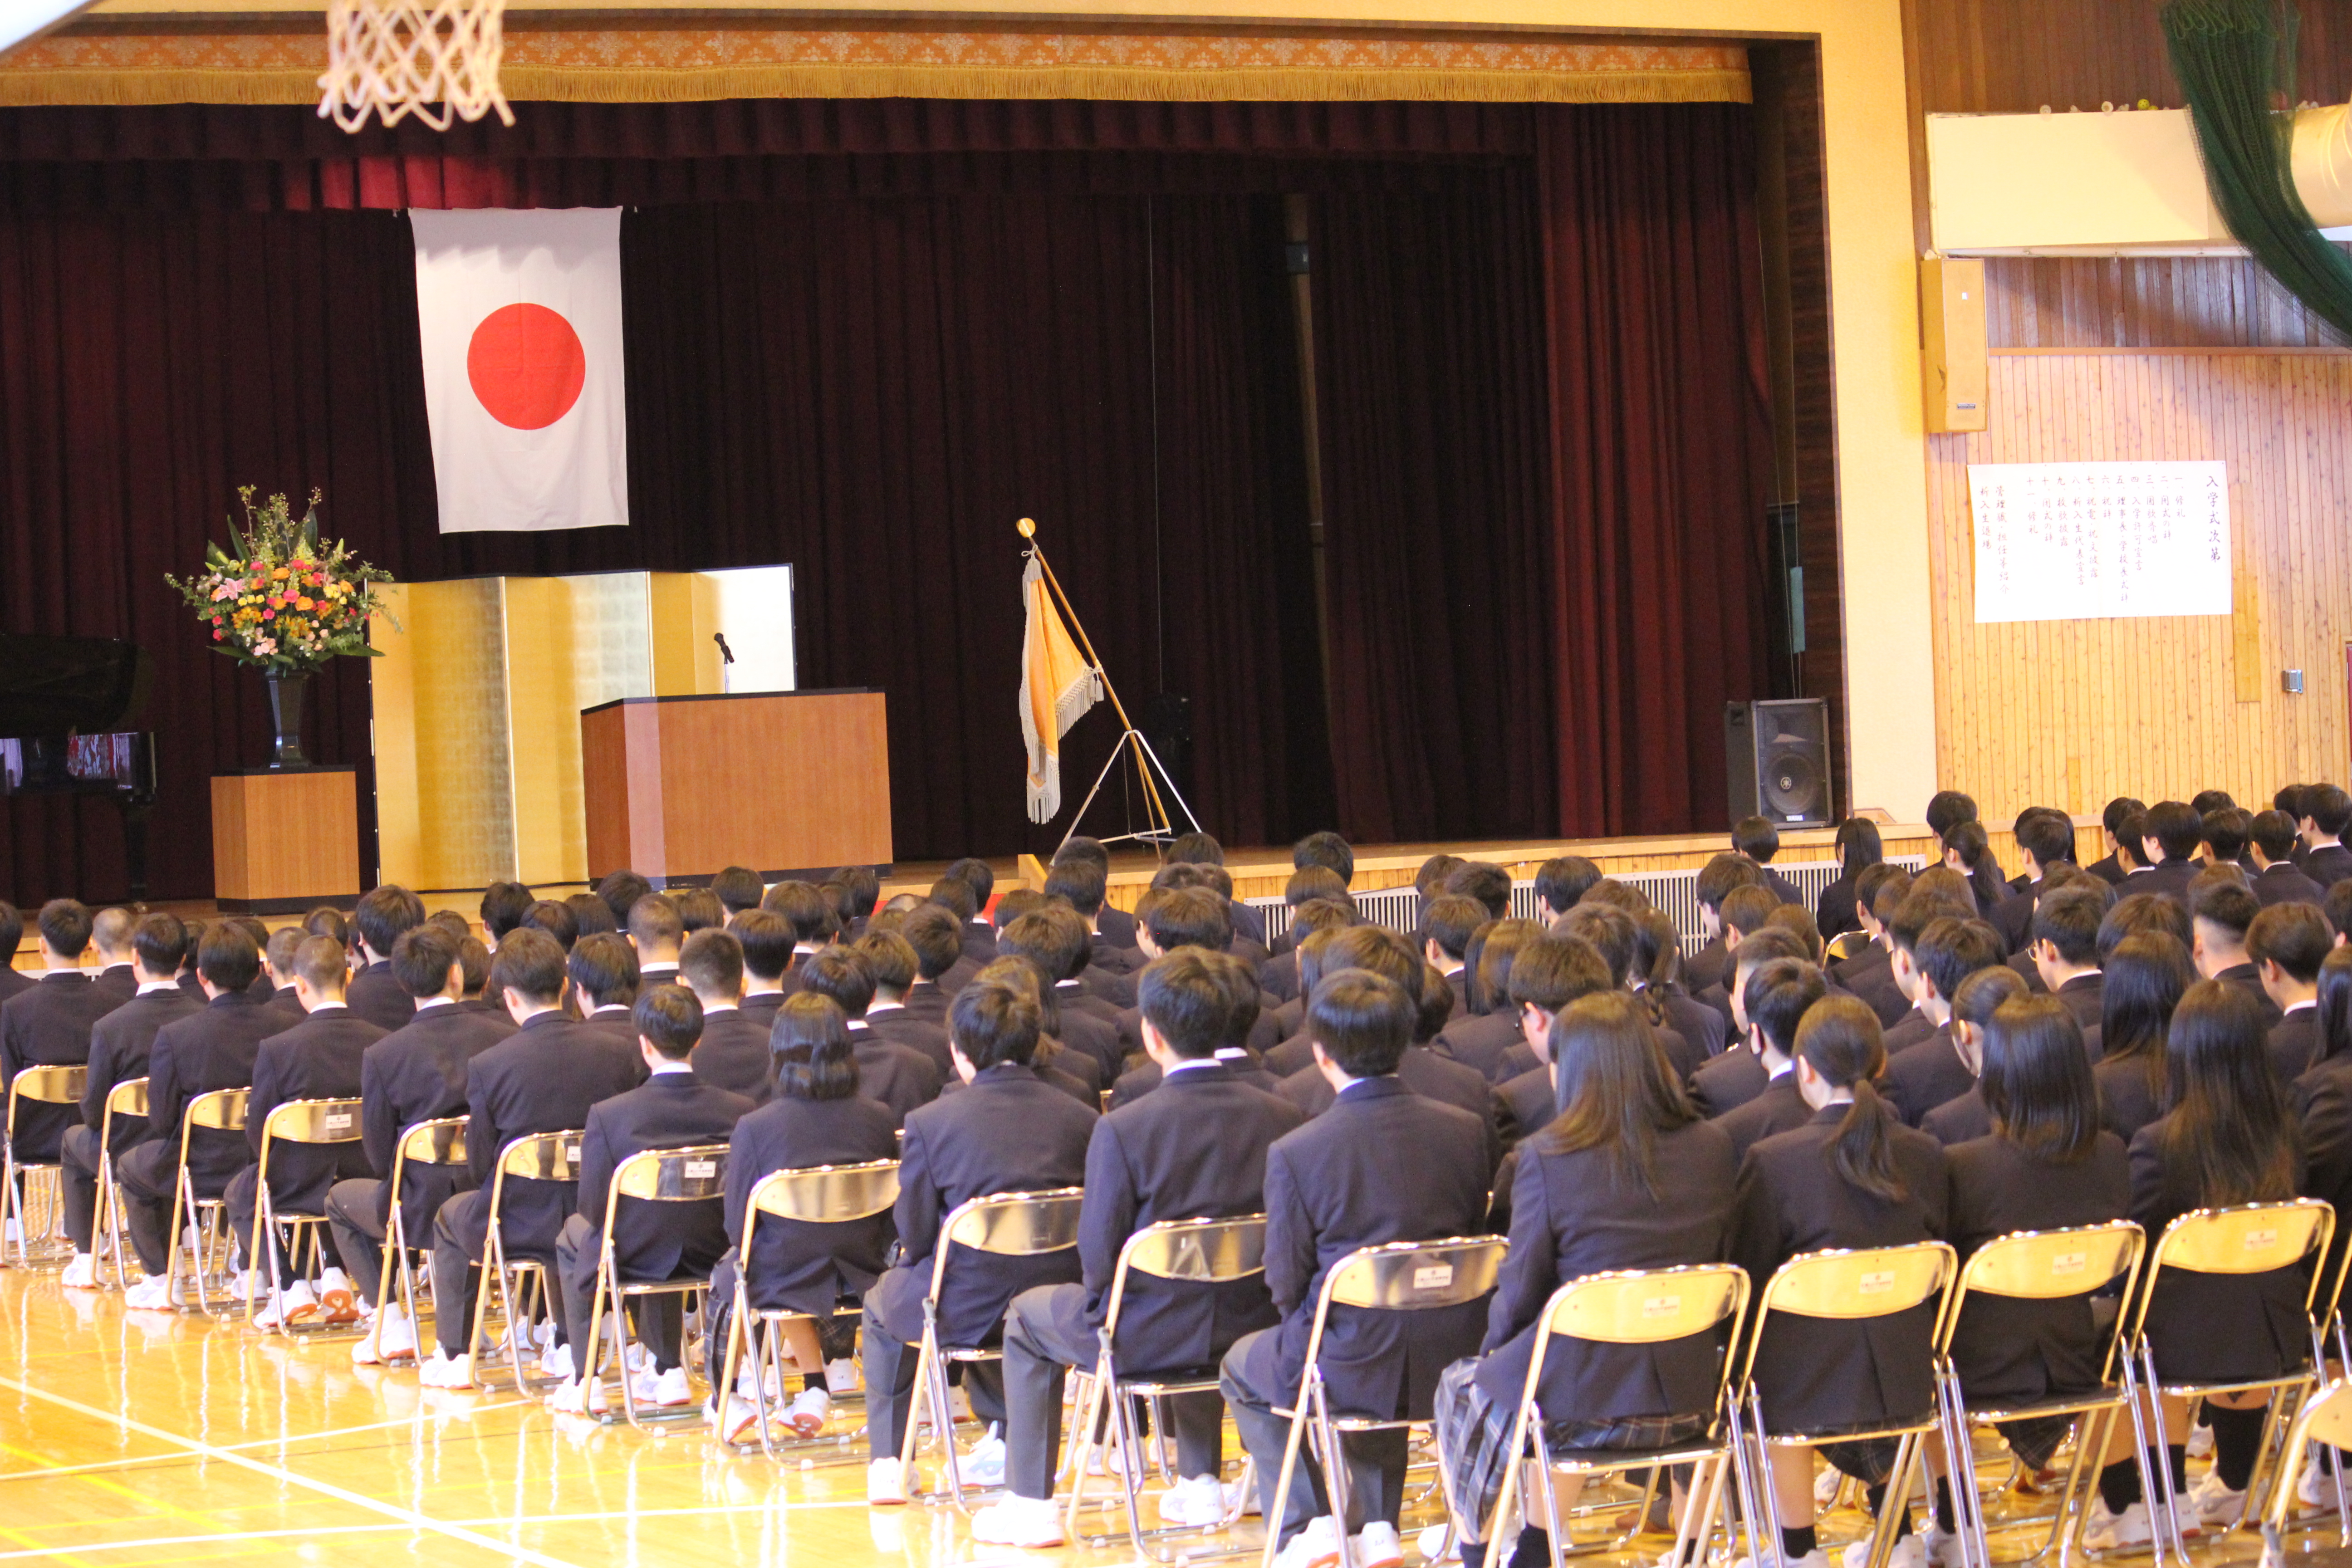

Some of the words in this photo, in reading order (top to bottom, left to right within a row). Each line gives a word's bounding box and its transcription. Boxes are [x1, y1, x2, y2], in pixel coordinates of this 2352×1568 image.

[1980, 487, 1991, 549] 新入生退場
[2206, 476, 2221, 563] 入学式次第
